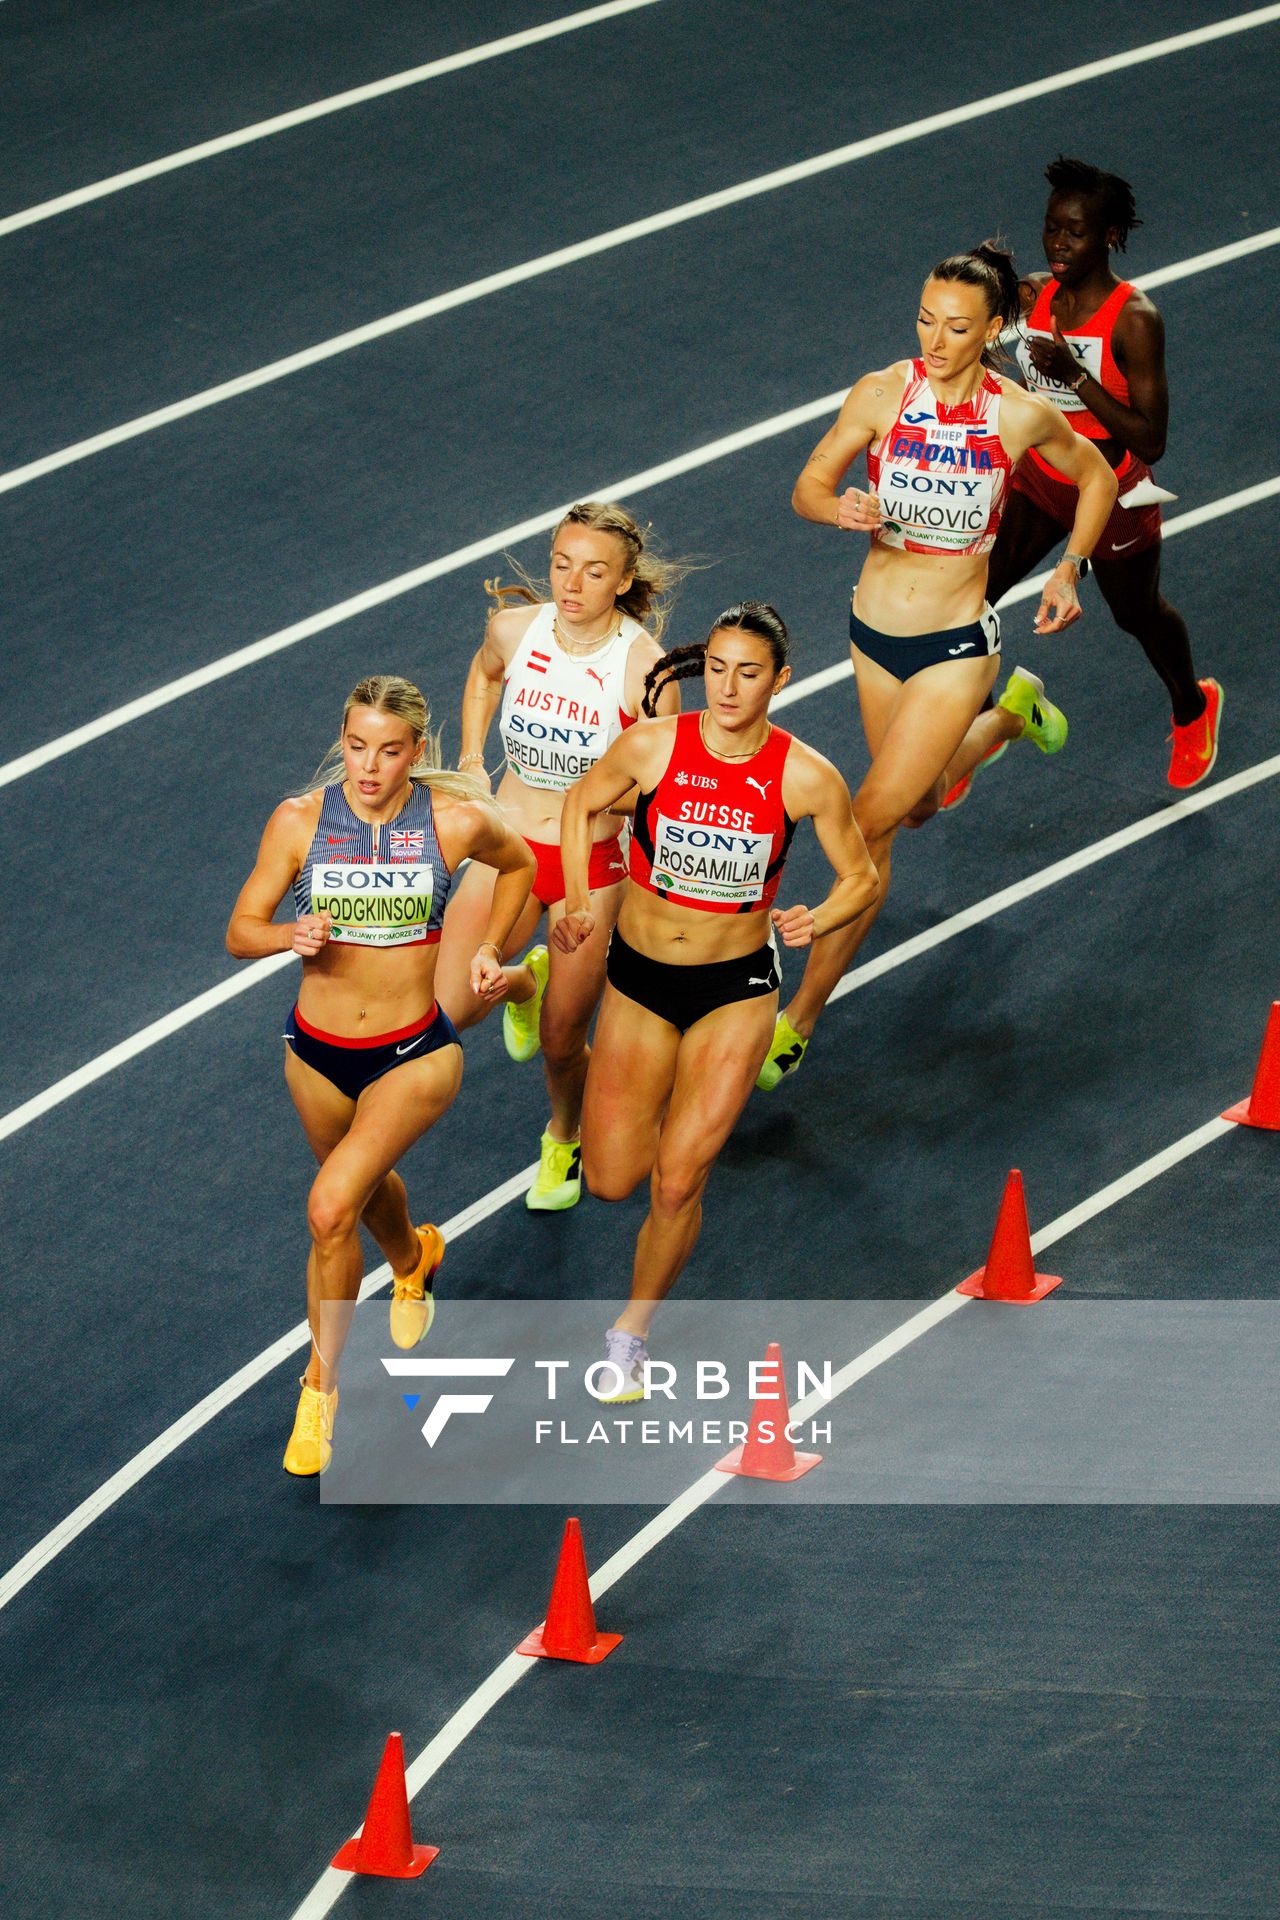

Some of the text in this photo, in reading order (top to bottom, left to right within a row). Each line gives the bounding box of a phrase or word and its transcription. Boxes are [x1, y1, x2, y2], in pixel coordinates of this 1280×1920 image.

[894, 437, 993, 470] CROATIA
[890, 471, 982, 497] SONY
[883, 498, 983, 530] VUKOVIĆ
[514, 687, 600, 726] AUSTRIA
[508, 714, 597, 748] SONY
[691, 774, 719, 790] UBS
[665, 825, 762, 855] SONY
[659, 845, 760, 883] ROSAMILIA
[323, 870, 421, 889] SONY
[678, 884, 711, 896] KUJAWY
[711, 890, 747, 898] POMORZE
[316, 896, 428, 922] HODGKINSON
[347, 930, 377, 940] KUJAWY
[378, 930, 412, 940] POMORZE
